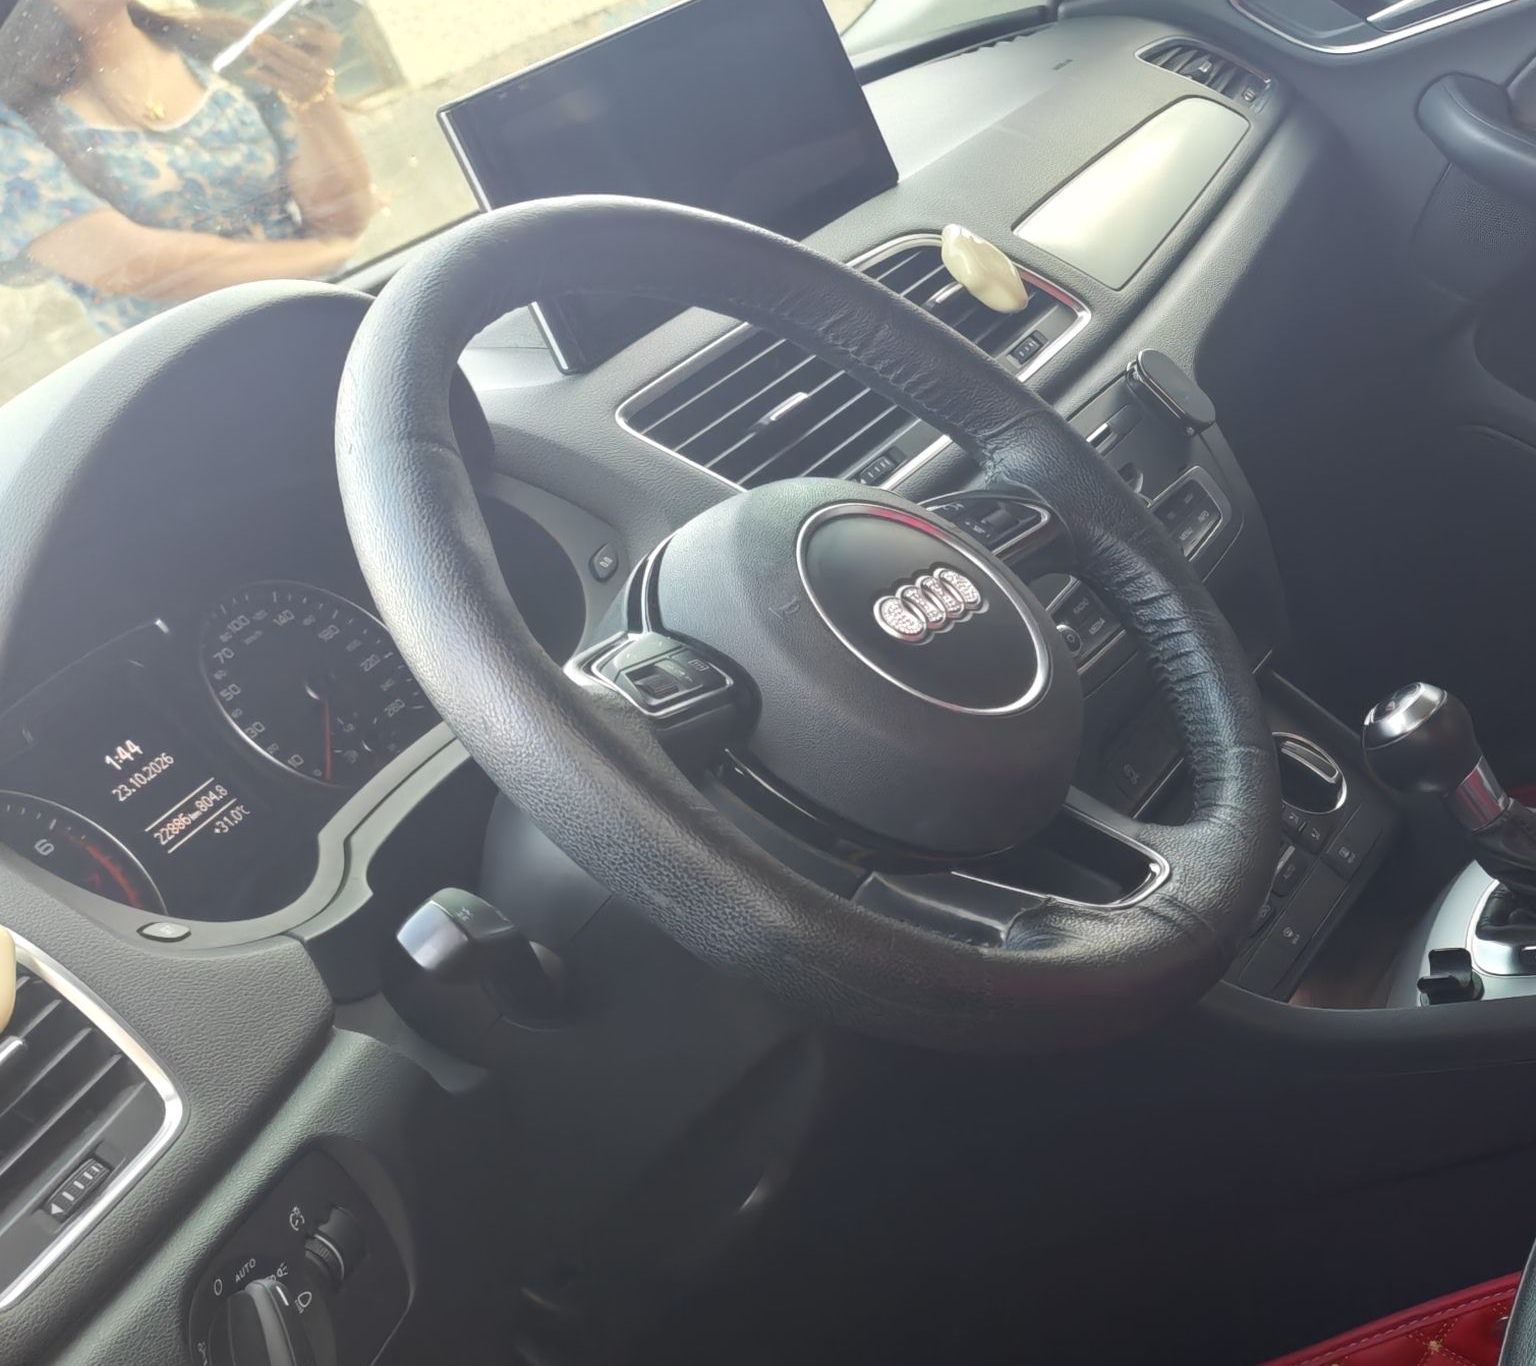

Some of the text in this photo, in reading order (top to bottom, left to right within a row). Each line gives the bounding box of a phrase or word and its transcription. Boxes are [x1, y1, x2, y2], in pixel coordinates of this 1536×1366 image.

[227, 615, 250, 633] 100
[213, 647, 235, 664] 70
[219, 683, 242, 702] 50
[244, 721, 266, 739] 30
[104, 739, 143, 770] 1:44
[287, 754, 304, 769] 10
[112, 752, 174, 802] 23.10.2026
[34, 838, 55, 856] 6
[234, 1258, 257, 1284] AUTO
